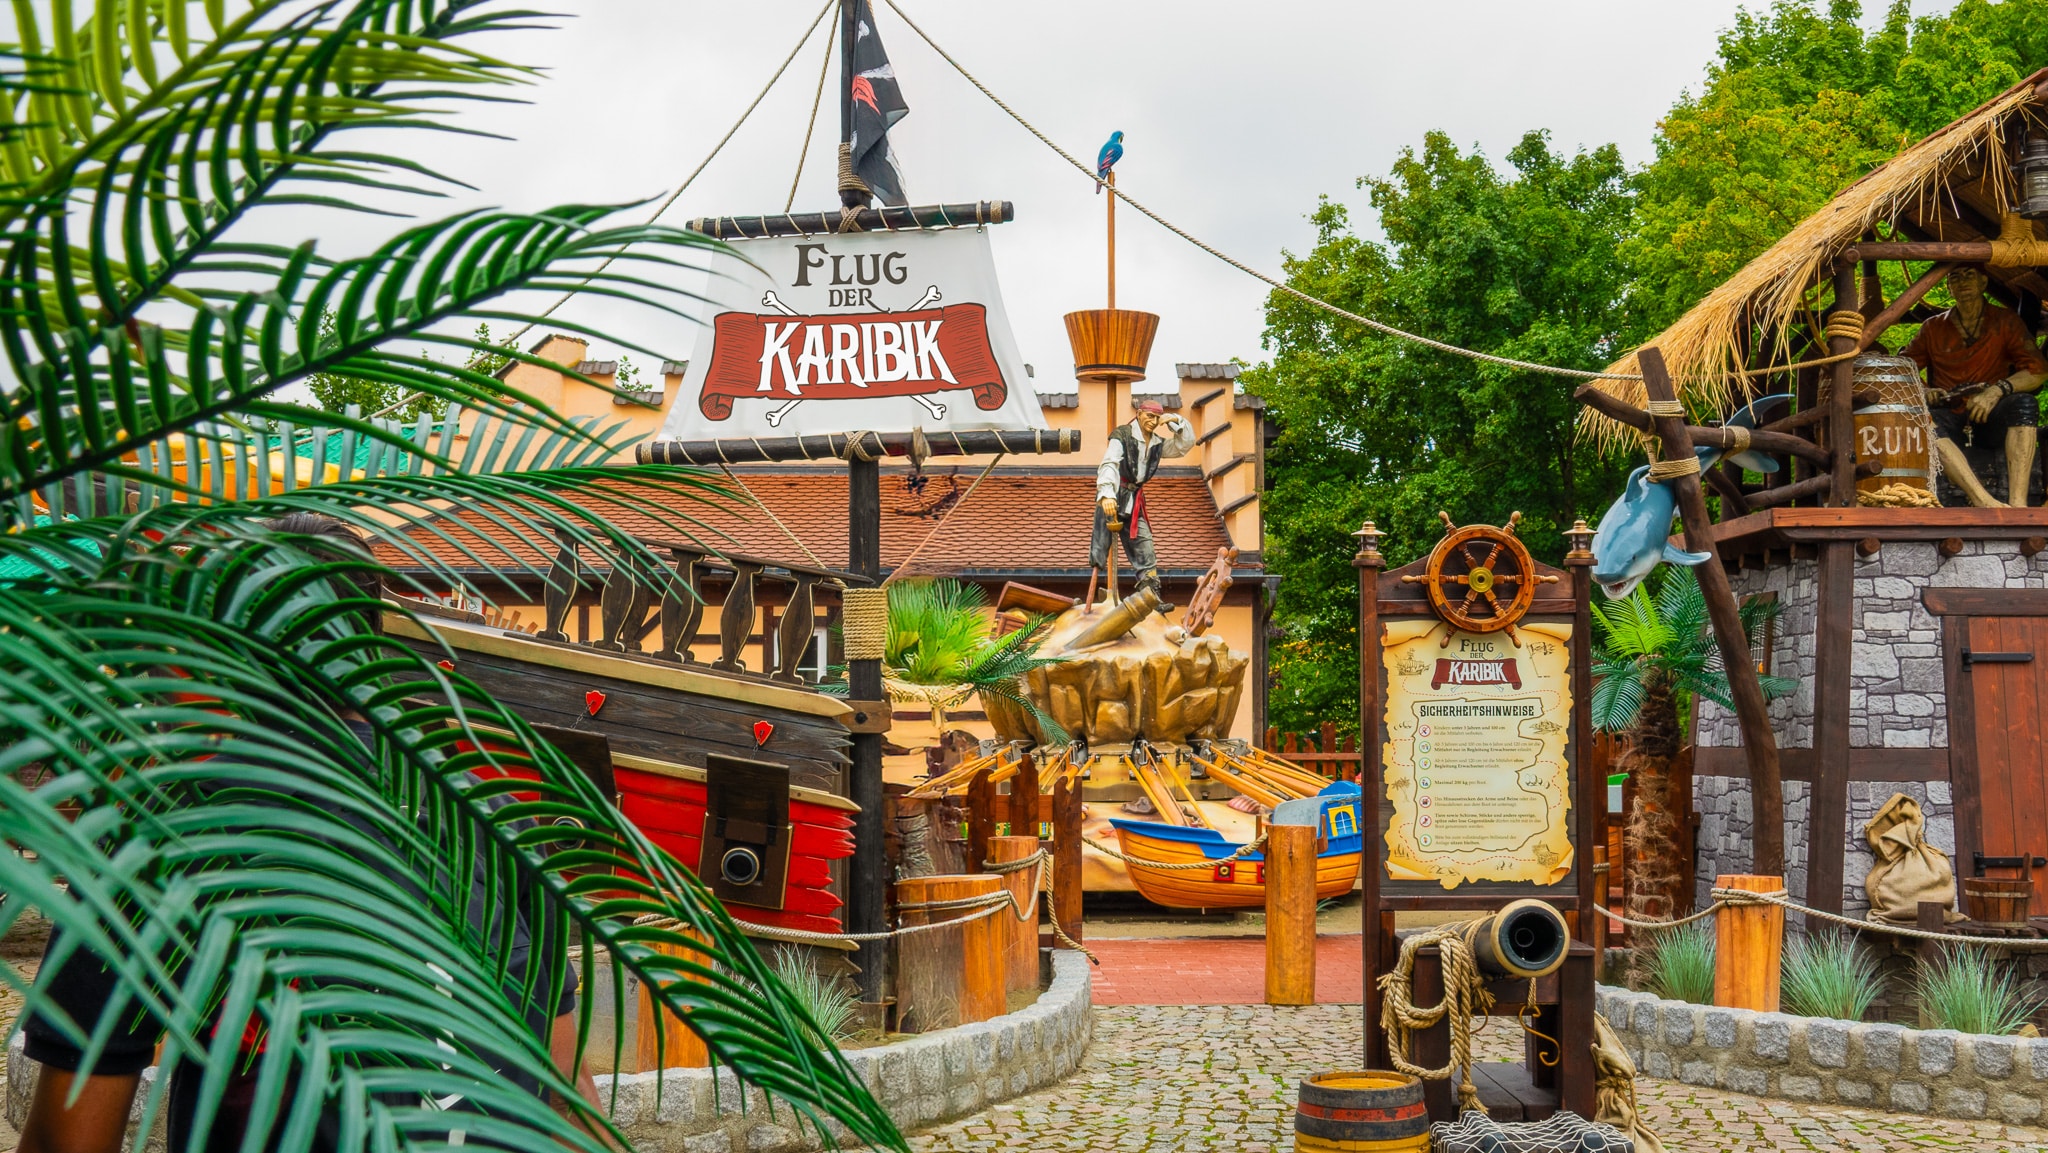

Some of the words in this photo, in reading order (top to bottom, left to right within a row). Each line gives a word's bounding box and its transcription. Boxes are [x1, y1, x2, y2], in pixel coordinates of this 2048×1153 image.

[828, 288, 891, 313] DER
[756, 320, 960, 396] KARIBIK
[1858, 425, 1924, 456] RUM
[1470, 652, 1487, 661] DER
[1448, 661, 1508, 684] KARIBIK
[1419, 705, 1535, 717] SICHERHEITSHINWEISE
